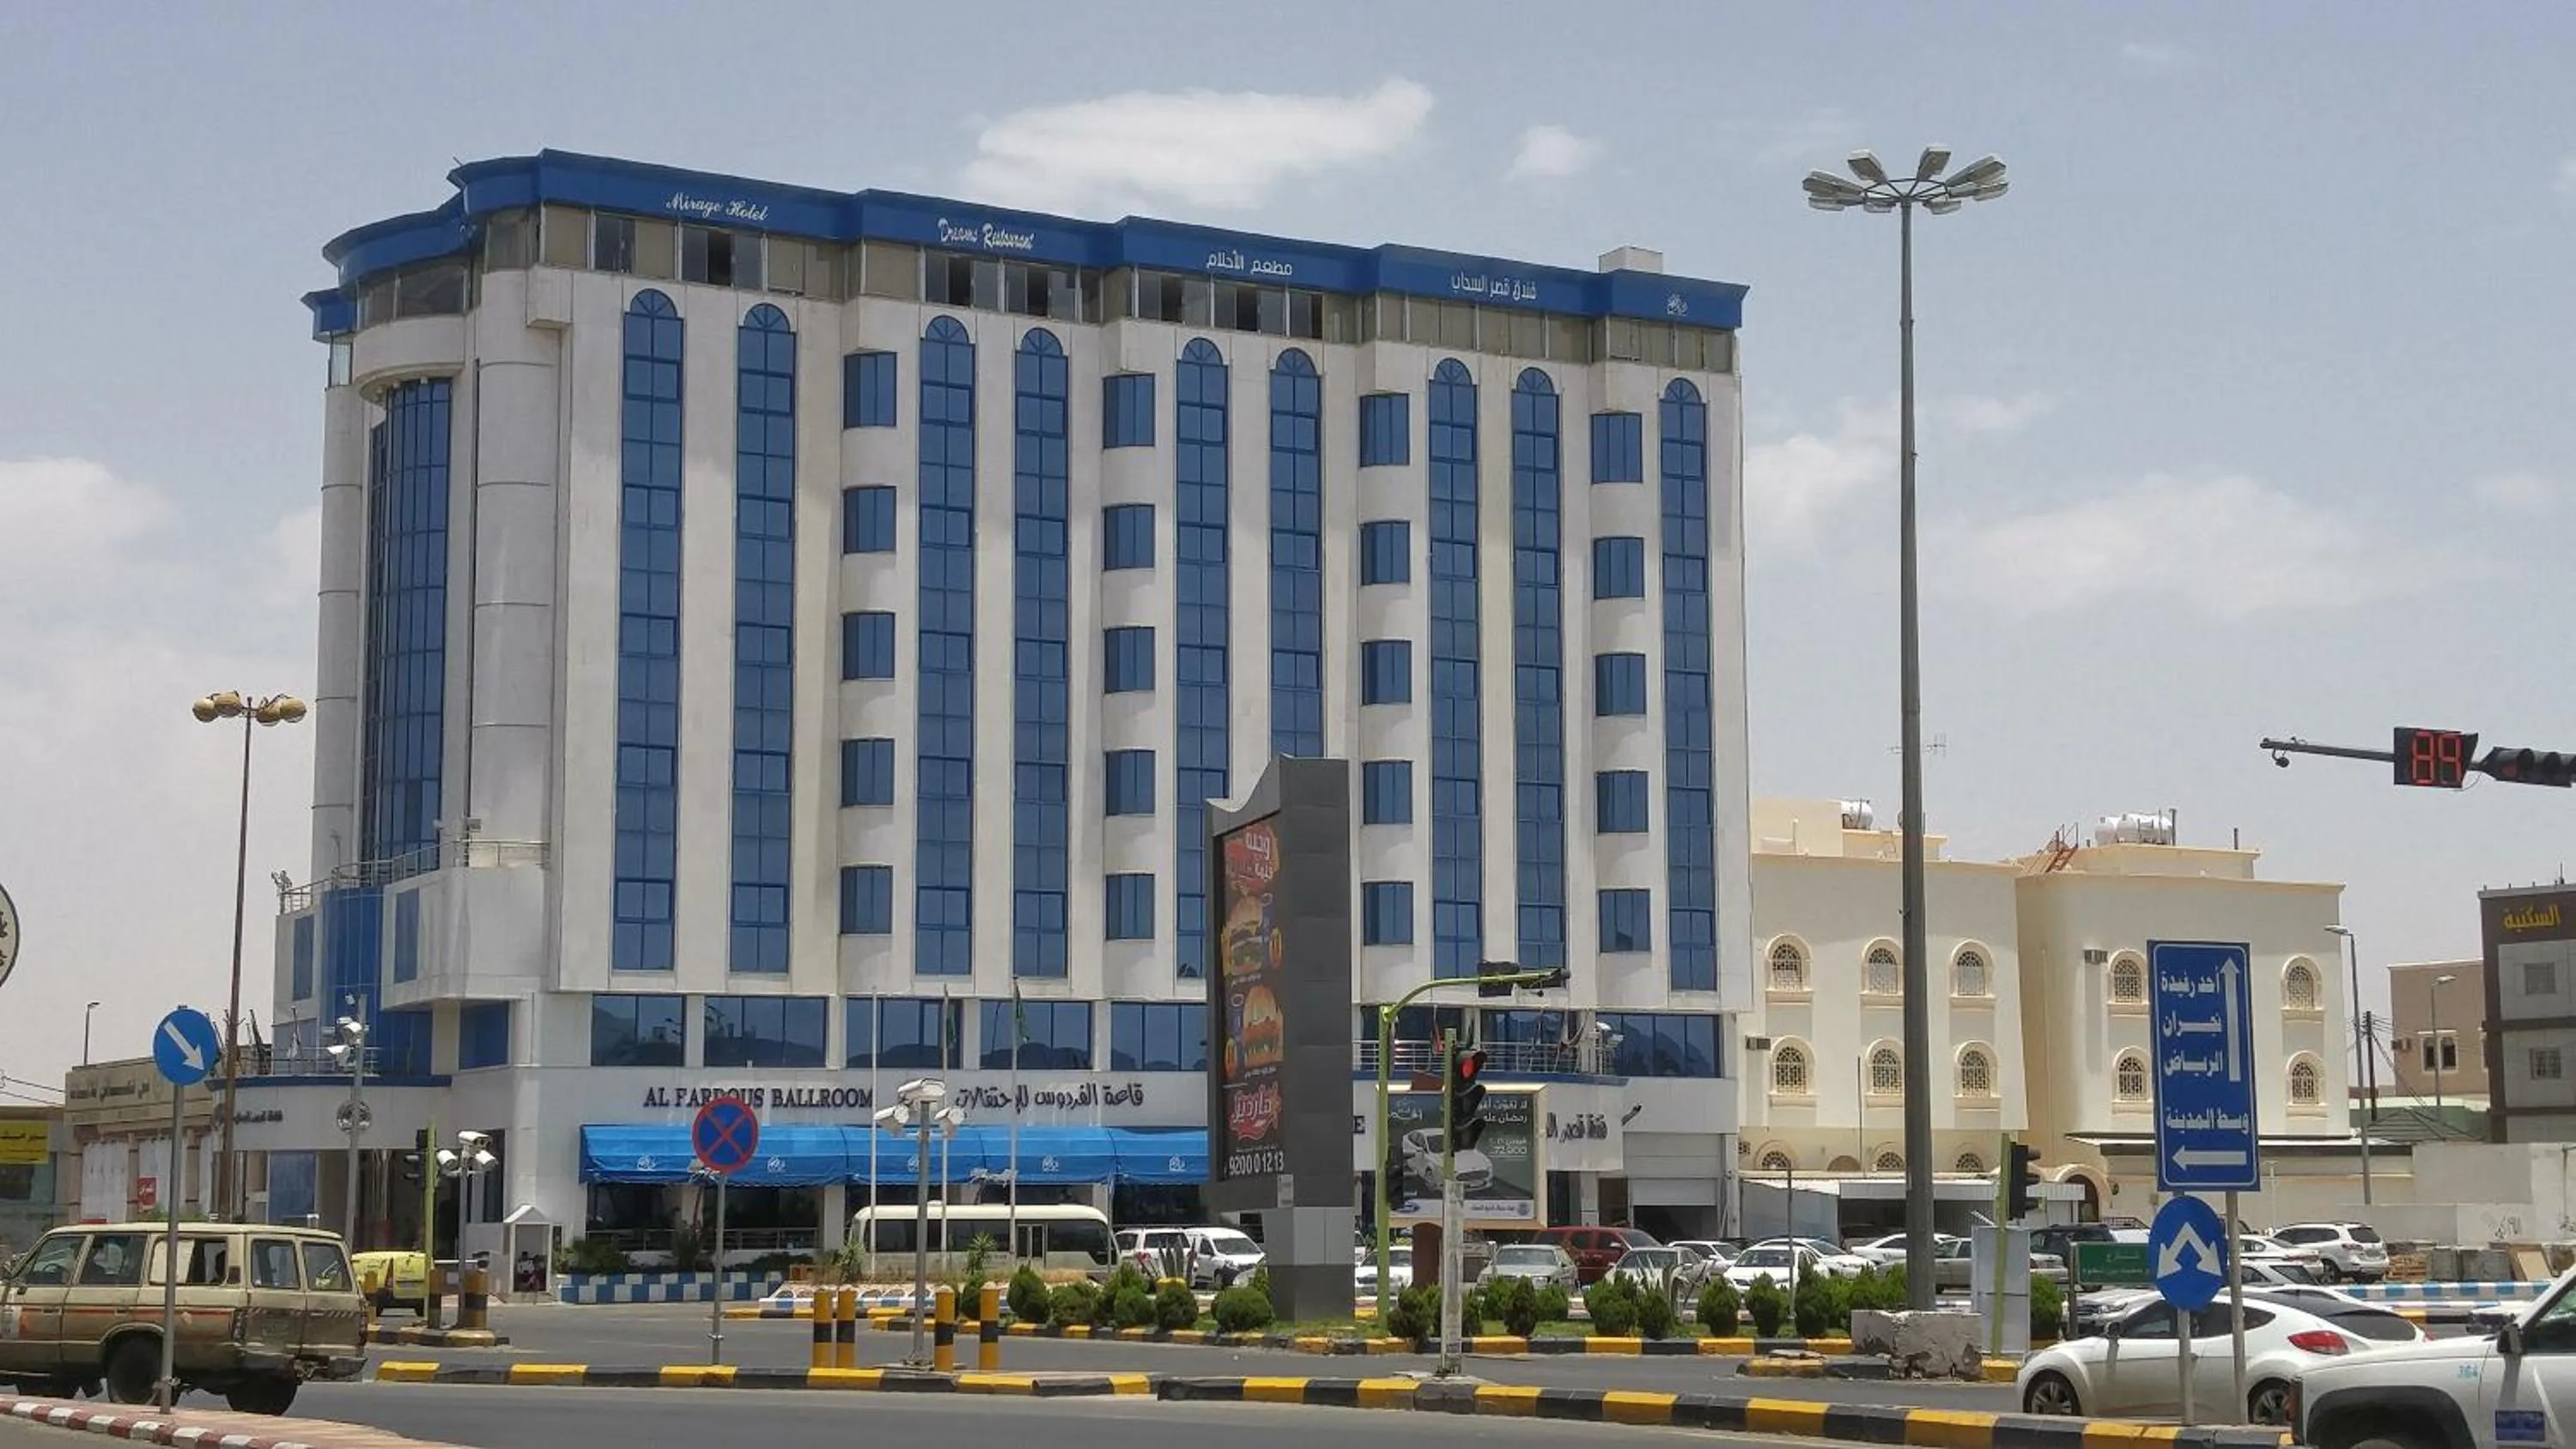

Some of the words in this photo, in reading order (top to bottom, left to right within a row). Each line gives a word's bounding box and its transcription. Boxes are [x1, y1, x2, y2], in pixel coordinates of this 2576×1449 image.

[666, 191, 722, 218] Mirage
[726, 200, 769, 221] Hotel
[1206, 249, 1245, 270] الأحلام
[1250, 260, 1292, 276] مطعم
[1451, 271, 1488, 294] السحاب
[1490, 277, 1510, 297] قصر
[1512, 279, 1537, 301] فندق
[2411, 731, 2463, 785] 89
[2160, 970, 2195, 998] رفيدة
[2197, 965, 2221, 994] أحد
[2162, 1010, 2222, 1037] نجران
[2163, 1050, 2223, 1078] الرياض
[644, 1087, 670, 1107] AL
[771, 1087, 873, 1108] BALLROOM
[1035, 1082, 1099, 1110] الفردوس
[1103, 1082, 1145, 1106] قاعة
[2165, 1107, 2215, 1135] المدينة
[2216, 1108, 2249, 1135] وسط
